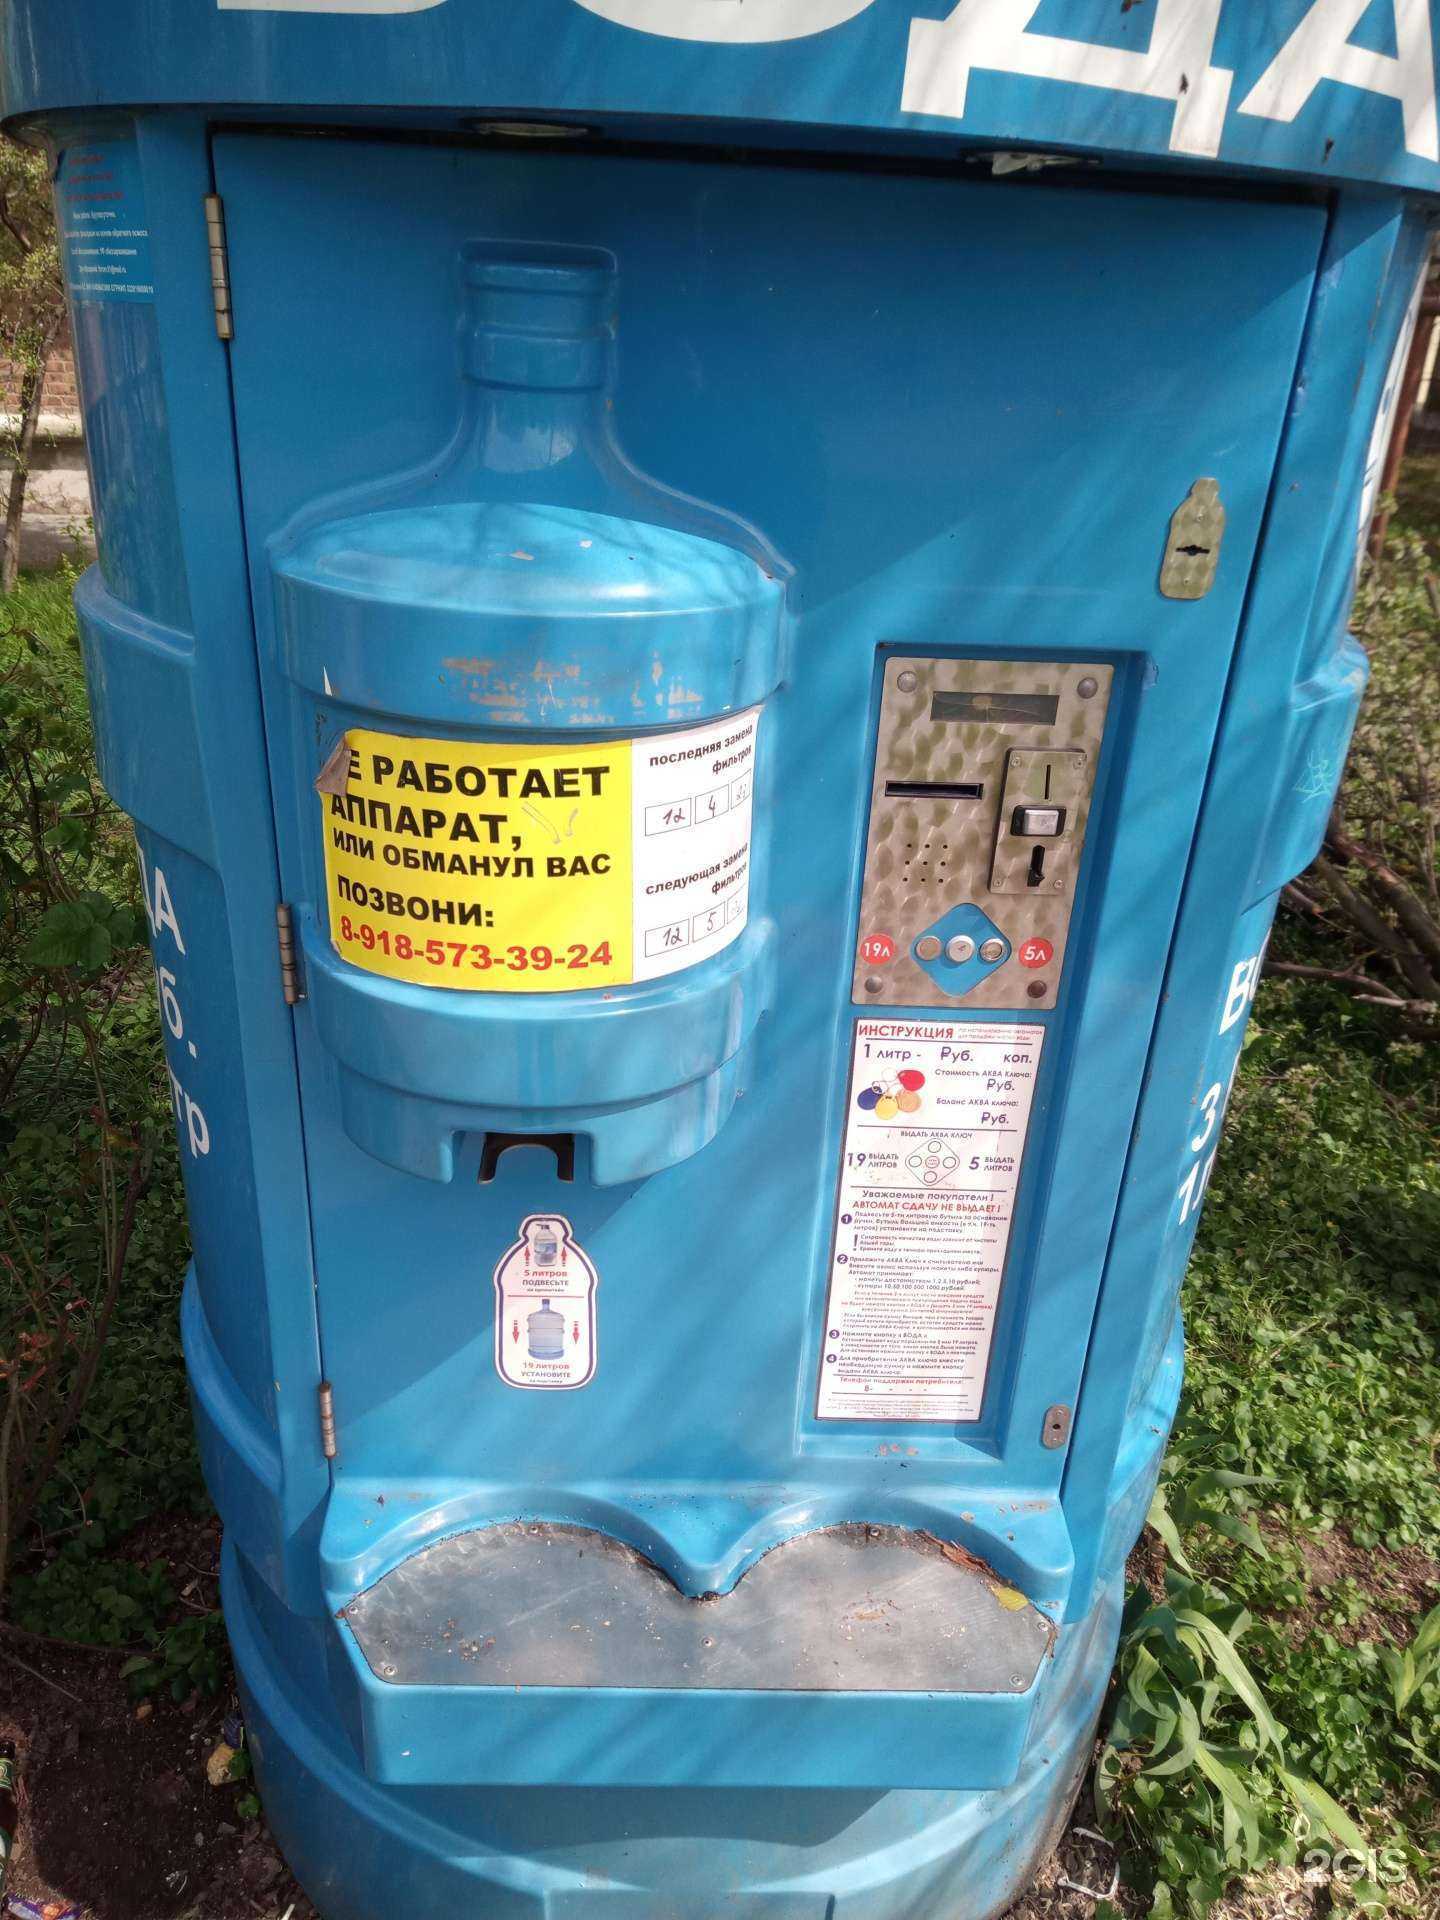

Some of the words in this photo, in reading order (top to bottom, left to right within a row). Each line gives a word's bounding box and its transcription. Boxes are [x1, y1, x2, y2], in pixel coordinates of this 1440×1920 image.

[649, 741, 722, 767] последняя
[724, 725, 753, 748] замена
[349, 749, 362, 781] Е
[372, 754, 610, 799] РАБОТАЕТ
[331, 794, 521, 852] АППАРАТ,
[333, 827, 374, 861] ИЛИ
[383, 844, 534, 878] ОБМАНУЛ
[546, 853, 611, 878] ВАС
[645, 863, 721, 895] следующая
[336, 875, 495, 928] ПОЗВОНИ:
[340, 915, 613, 971] 8-918-573-39-24
[863, 942, 891, 958] 19л
[1024, 946, 1047, 961] 5л
[858, 1025, 954, 1039] ИНСТРУКЦИЯ
[863, 1044, 871, 1058] 1
[876, 1048, 912, 1062] литр
[1003, 1052, 1032, 1064] коп.
[934, 1068, 980, 1076] Стоимость
[1004, 1070, 1032, 1078] Ключа:
[936, 1097, 966, 1105] Баланс
[847, 1152, 867, 1167] 19
[868, 1152, 899, 1161] ВЫДАТЬ
[868, 1160, 898, 1168] ЛИТРОВ
[968, 1156, 980, 1171] 5
[983, 1164, 1013, 1172] ЛИТРОВ
[862, 1190, 925, 1200] Уважаемые
[928, 1192, 988, 1202] покупатели
[852, 1200, 901, 1210] АВТОМАТ
[902, 1202, 938, 1211] СДАЧУ
[941, 1204, 954, 1212] НЕ
[524, 1269, 530, 1277] 5
[532, 1270, 568, 1278] литров
[522, 1279, 569, 1287] ПОДВЕСЬТЕ
[520, 1370, 571, 1378] УСТАНОВИТЕ
[522, 1362, 534, 1370] 19
[535, 1363, 570, 1371] литров
